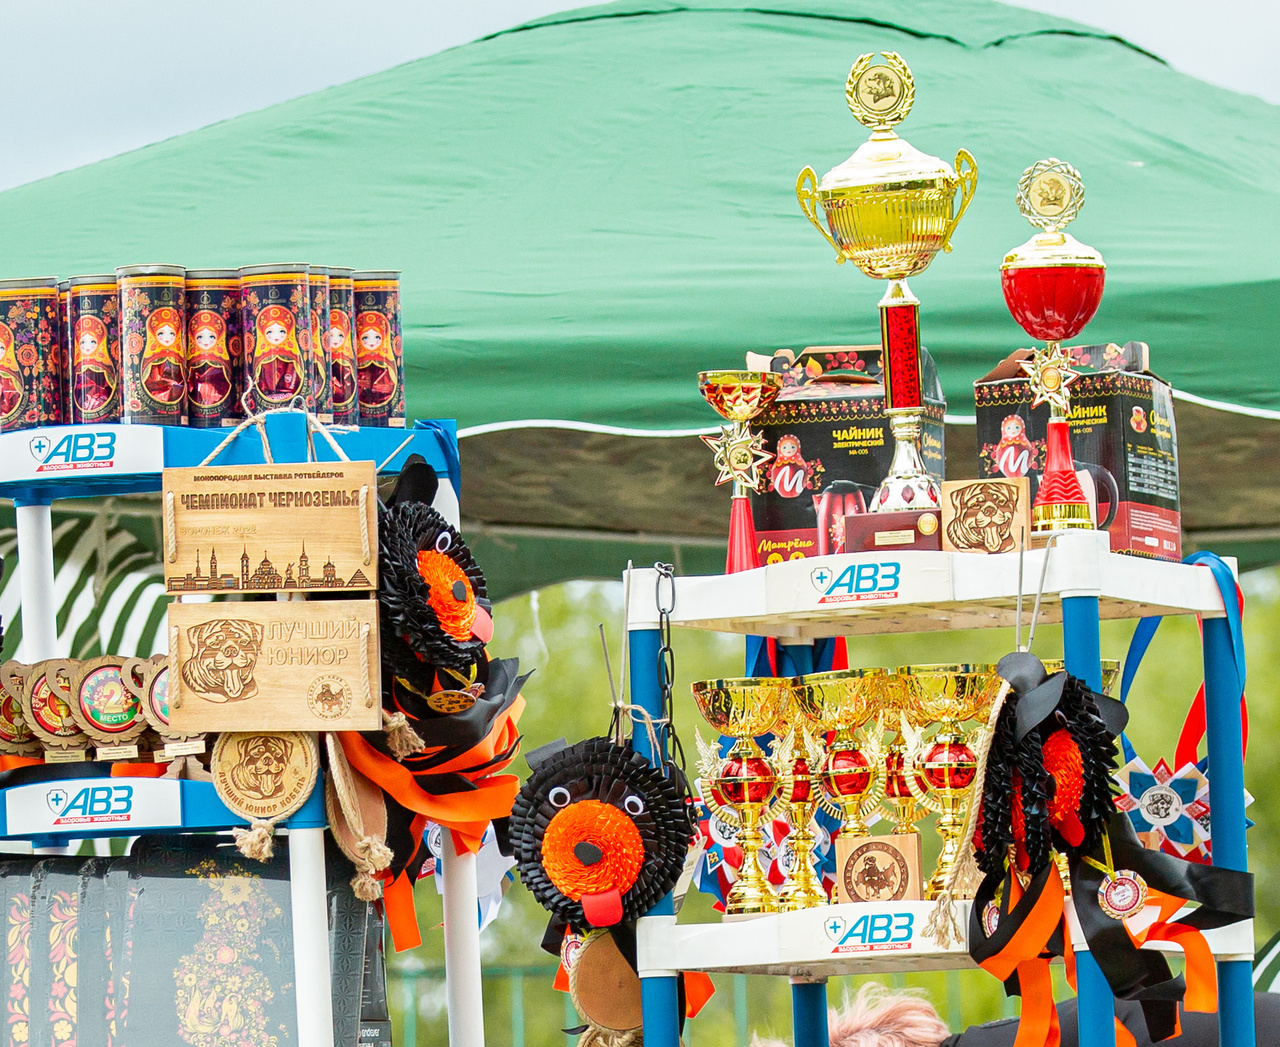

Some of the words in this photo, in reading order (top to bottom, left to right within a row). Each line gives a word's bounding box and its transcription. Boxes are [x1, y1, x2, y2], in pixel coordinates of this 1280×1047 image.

[1065, 404, 1107, 419] АЙНИК
[832, 426, 884, 441] ЧАЙНИК
[253, 472, 293, 481] ВЫСТАВКА
[294, 470, 344, 480] РОТВЕЙЛЕРОВ
[181, 492, 266, 510] ЧЕМПИОНАТ
[269, 489, 360, 508] ЧЕРНОЗЕМЬЯ
[179, 525, 230, 535] ВОРОНЕЖ
[233, 524, 257, 534] 2022
[758, 538, 815, 553] Матрёна
[267, 616, 361, 642] ЛУЧШИЙ
[267, 646, 349, 666] ЮНИОР
[103, 682, 121, 713] 2
[100, 714, 129, 723] МЕСТО
[218, 771, 245, 807] ЛУЧШИЙ
[245, 803, 278, 814] ЮНИОР
[281, 776, 306, 808] КОБЕЛЬ
